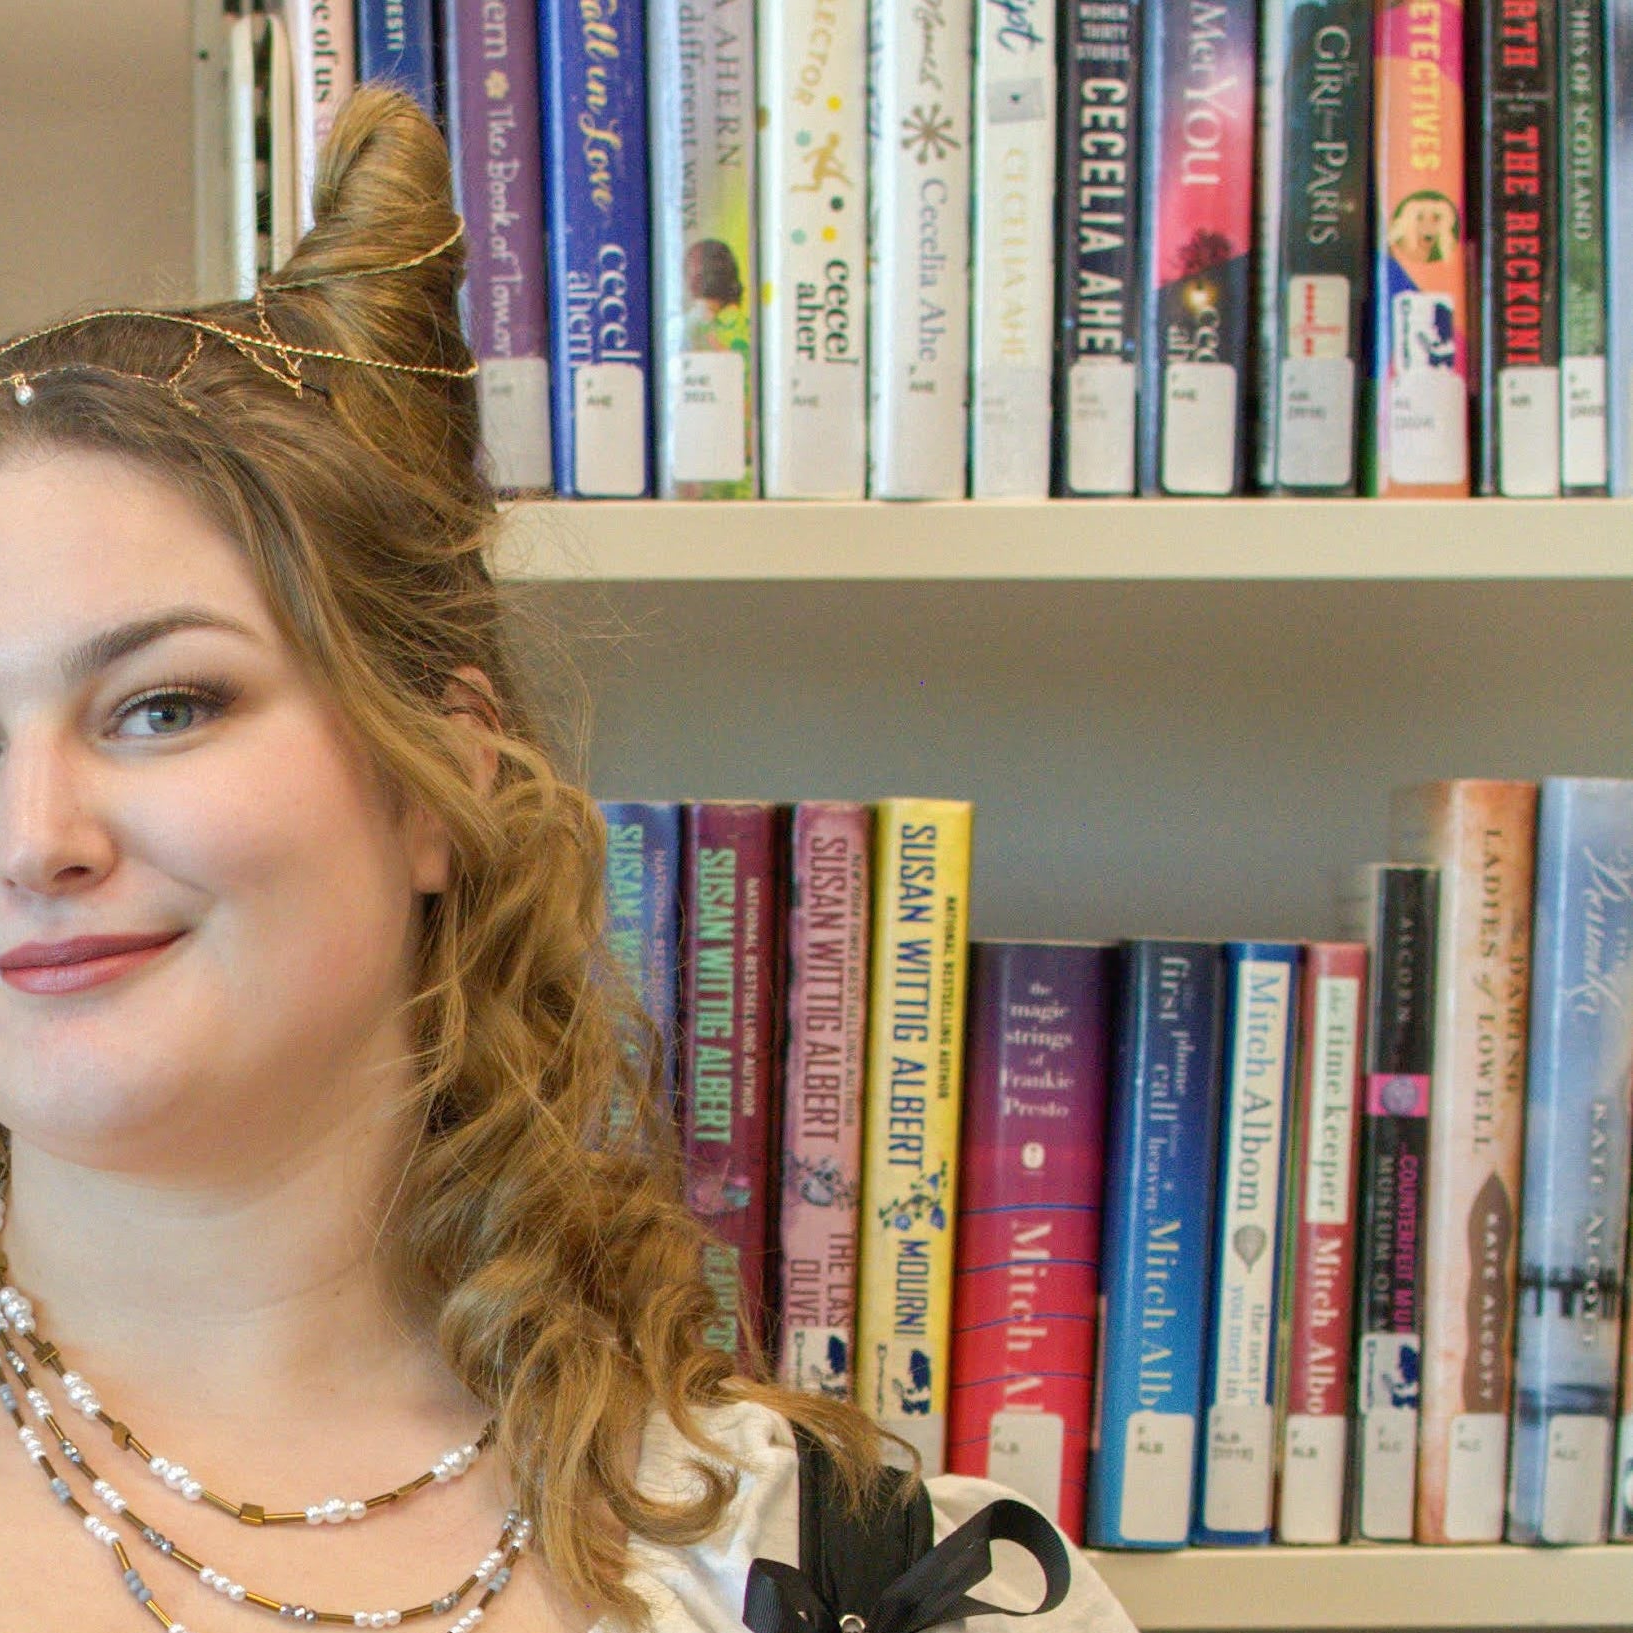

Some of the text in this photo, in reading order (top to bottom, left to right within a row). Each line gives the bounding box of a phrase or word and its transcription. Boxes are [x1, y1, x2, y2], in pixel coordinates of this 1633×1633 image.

[1079, 78, 1128, 252] CECELIA
[1503, 125, 1541, 195] THE
[1480, 828, 1504, 956] LADIES
[692, 847, 738, 1145] SUSAN WITTIG ALBERT
[800, 836, 848, 1144] SUSAN WITTIG ALBERT
[887, 823, 938, 1171] SUSAN WITTIG ALBERT
[940, 961, 957, 1047] BESTSELLING
[1004, 1029, 1073, 1049] strings
[1151, 956, 1195, 1121] first phone call
[740, 1054, 757, 1117] AUTHOR
[936, 1051, 953, 1099] AUTHOR
[1002, 1070, 1074, 1089] Frankie
[1003, 1098, 1070, 1118] Presto
[1236, 973, 1282, 1212] Mitch Albom
[1310, 1025, 1349, 1213] time keeper
[828, 1231, 854, 1274] THE
[1005, 1221, 1052, 1352] Mitch
[1145, 1220, 1183, 1328] Mitch
[1308, 1236, 1340, 1328] Mitch
[1479, 1211, 1501, 1398] KATE ALCOTT
